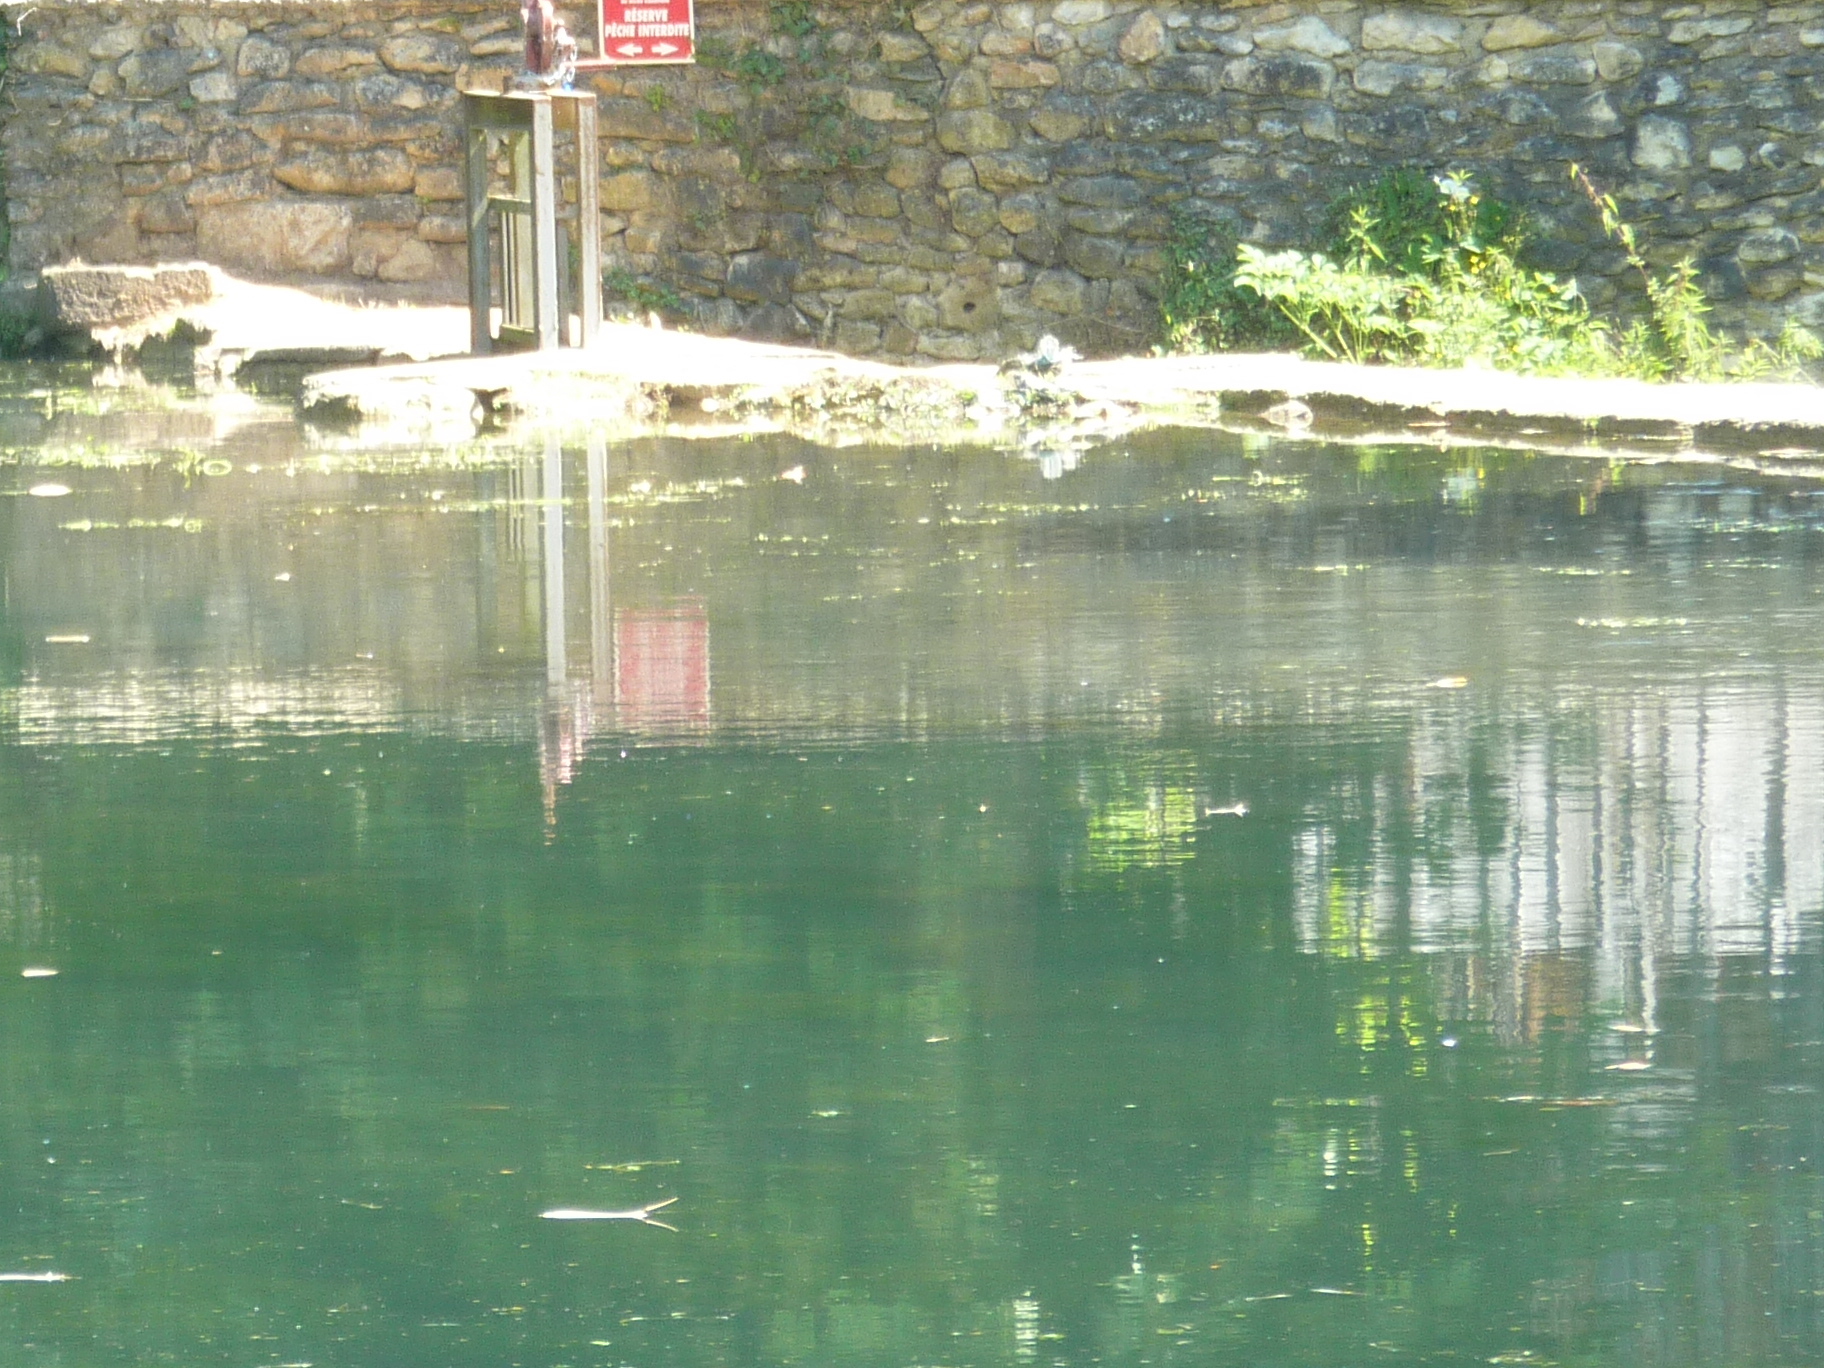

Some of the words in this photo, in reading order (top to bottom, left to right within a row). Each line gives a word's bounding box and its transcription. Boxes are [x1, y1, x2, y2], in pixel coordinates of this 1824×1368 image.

[624, 8, 668, 22] RÉSERVE
[605, 22, 636, 38] PÊCHE
[638, 24, 690, 37] INTERDITE
